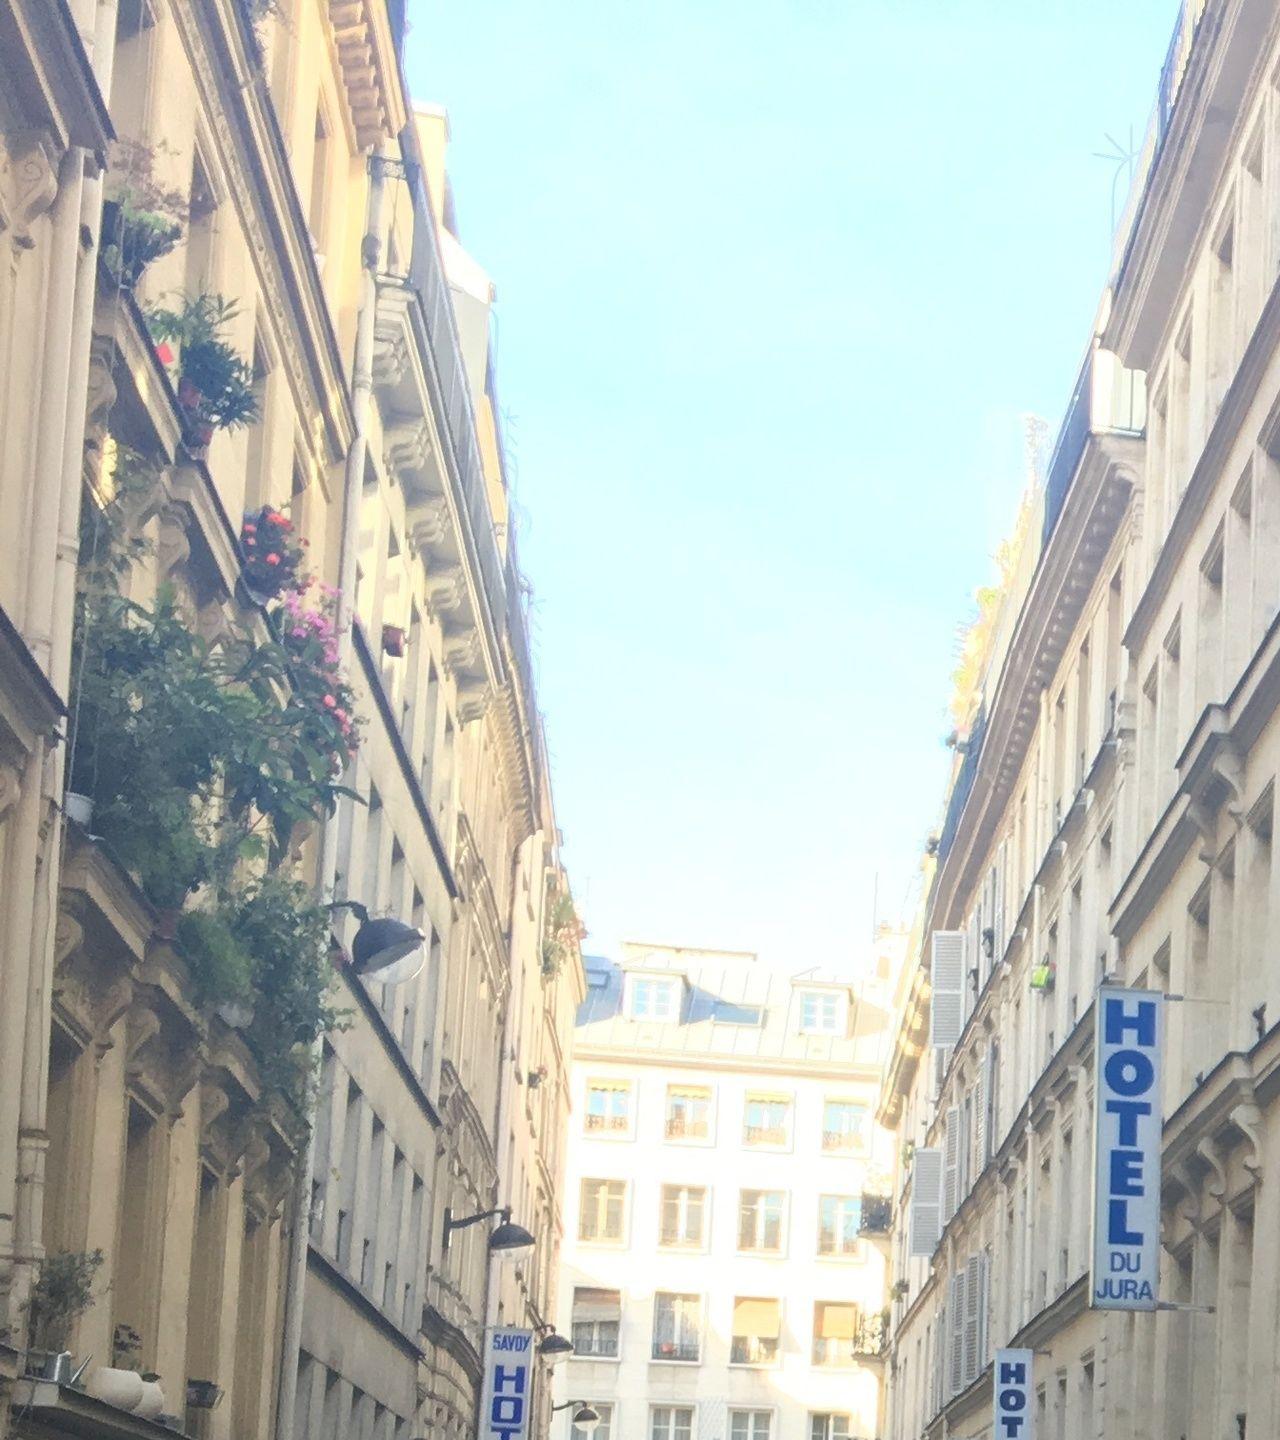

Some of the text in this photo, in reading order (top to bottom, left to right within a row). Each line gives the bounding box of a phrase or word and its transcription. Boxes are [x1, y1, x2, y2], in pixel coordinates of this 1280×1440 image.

[1104, 998, 1156, 1246] HOTEL
[1110, 1252, 1141, 1273] DU
[1096, 1278, 1153, 1300] JURA
[493, 1333, 531, 1352] SAVOY
